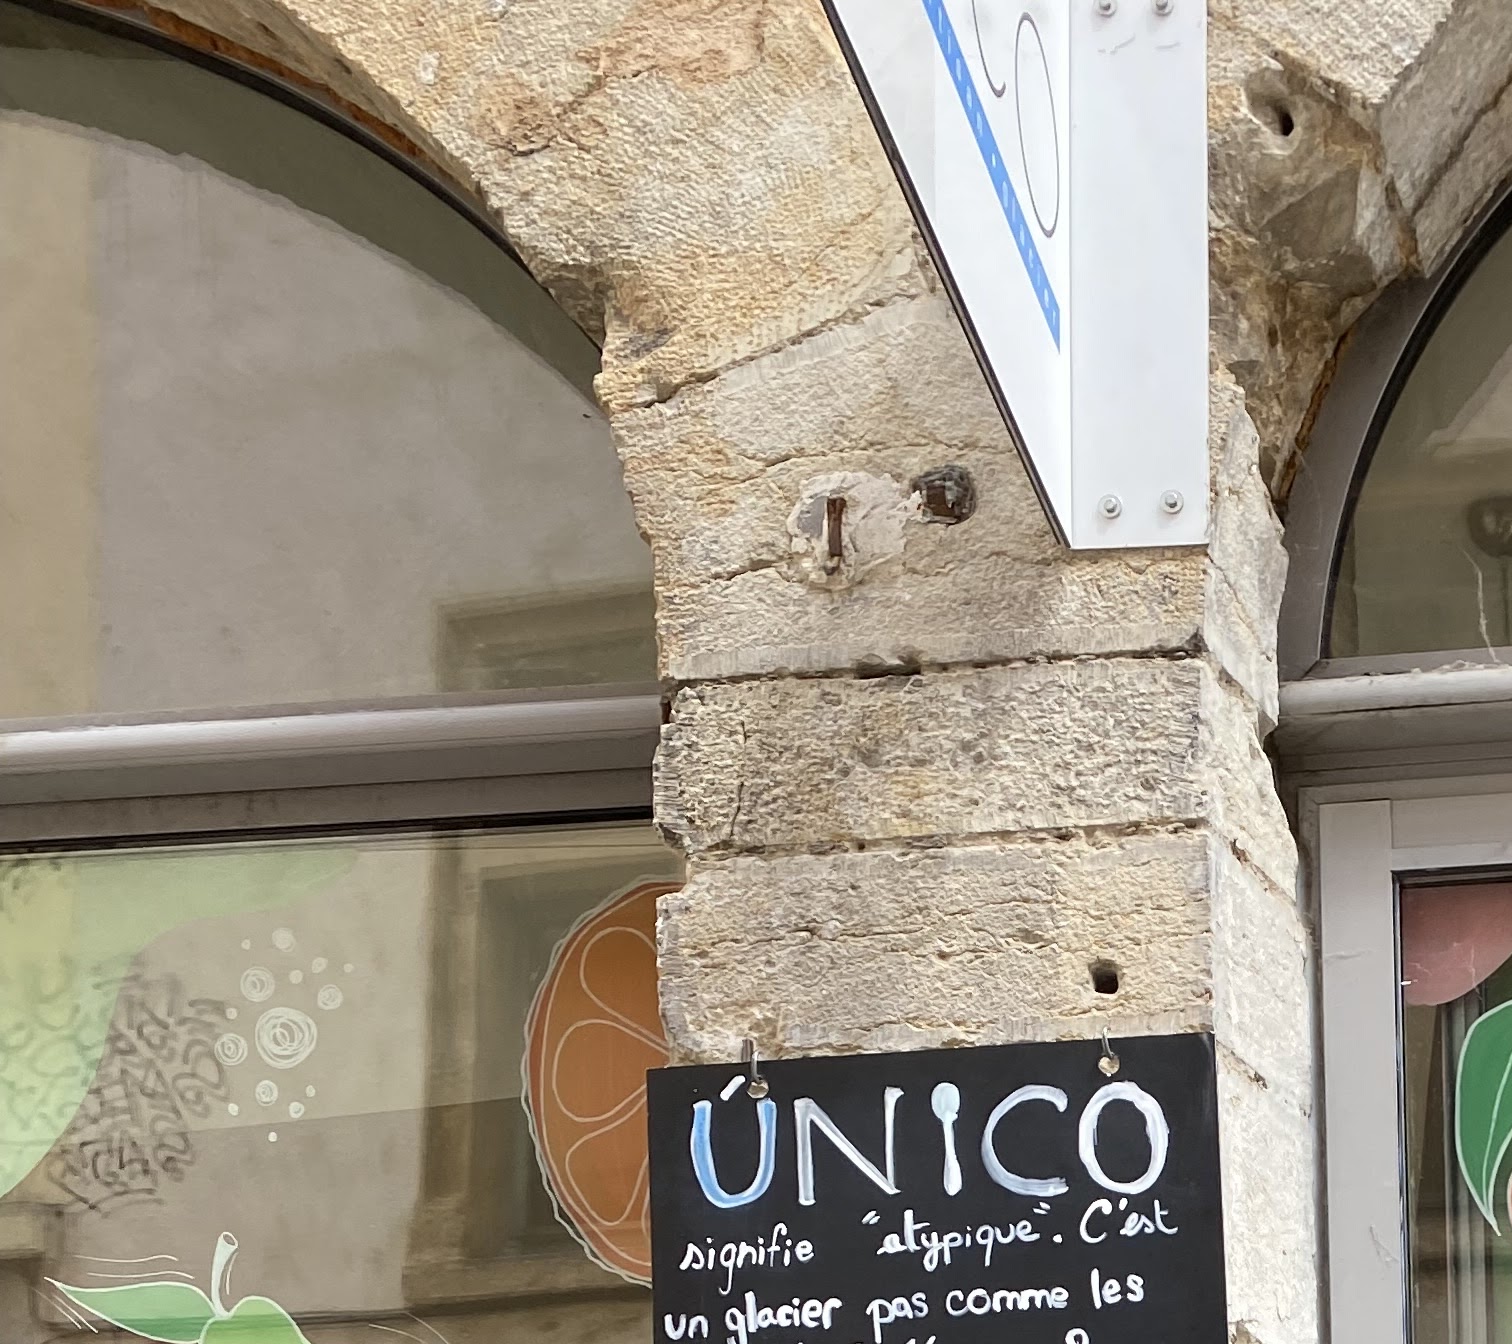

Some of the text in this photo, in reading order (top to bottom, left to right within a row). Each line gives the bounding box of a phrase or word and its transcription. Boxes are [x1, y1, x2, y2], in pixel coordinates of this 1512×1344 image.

[679, 1223, 815, 1294] signifie
[1079, 1197, 1178, 1244] C'est
[664, 1310, 709, 1342] un
[865, 1297, 930, 1344] pas
[945, 1284, 1069, 1318] comme
[1091, 1268, 1146, 1310] les
